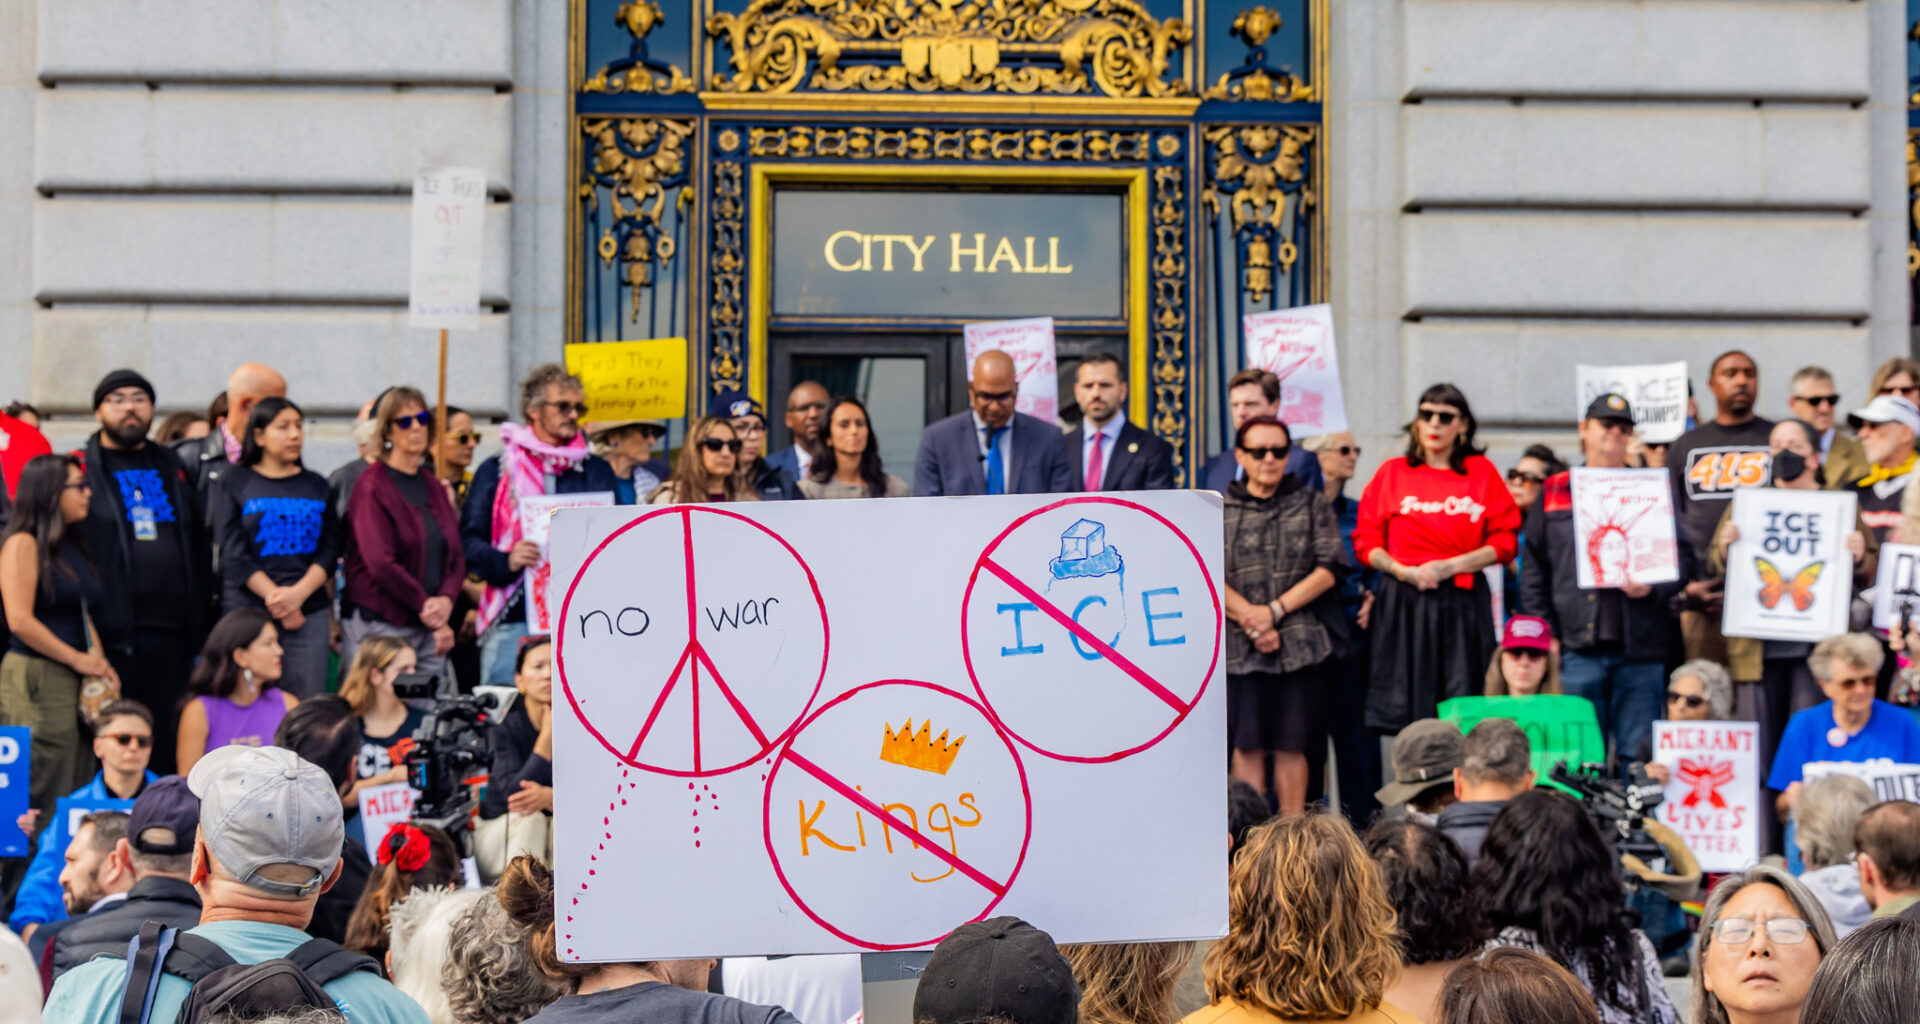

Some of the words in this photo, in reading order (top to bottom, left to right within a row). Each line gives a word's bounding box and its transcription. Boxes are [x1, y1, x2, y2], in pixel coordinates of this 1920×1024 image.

[824, 230, 936, 272] CITY
[949, 233, 1073, 274] HALL
[625, 351, 664, 371] They
[1636, 376, 1681, 402] ICE
[1689, 452, 1769, 491] 415
[1400, 496, 1442, 515] Free
[1444, 496, 1486, 523] City
[1764, 511, 1821, 535] ICE
[1763, 536, 1820, 557] OUT
[579, 606, 650, 639] no
[706, 597, 779, 633] war
[996, 586, 1187, 662] ICE
[1660, 728, 1753, 751] MIGRANT
[357, 743, 392, 779] CE
[1667, 803, 1746, 831] LIVES
[799, 785, 982, 883] Kings
[1690, 834, 1743, 853] TTER
